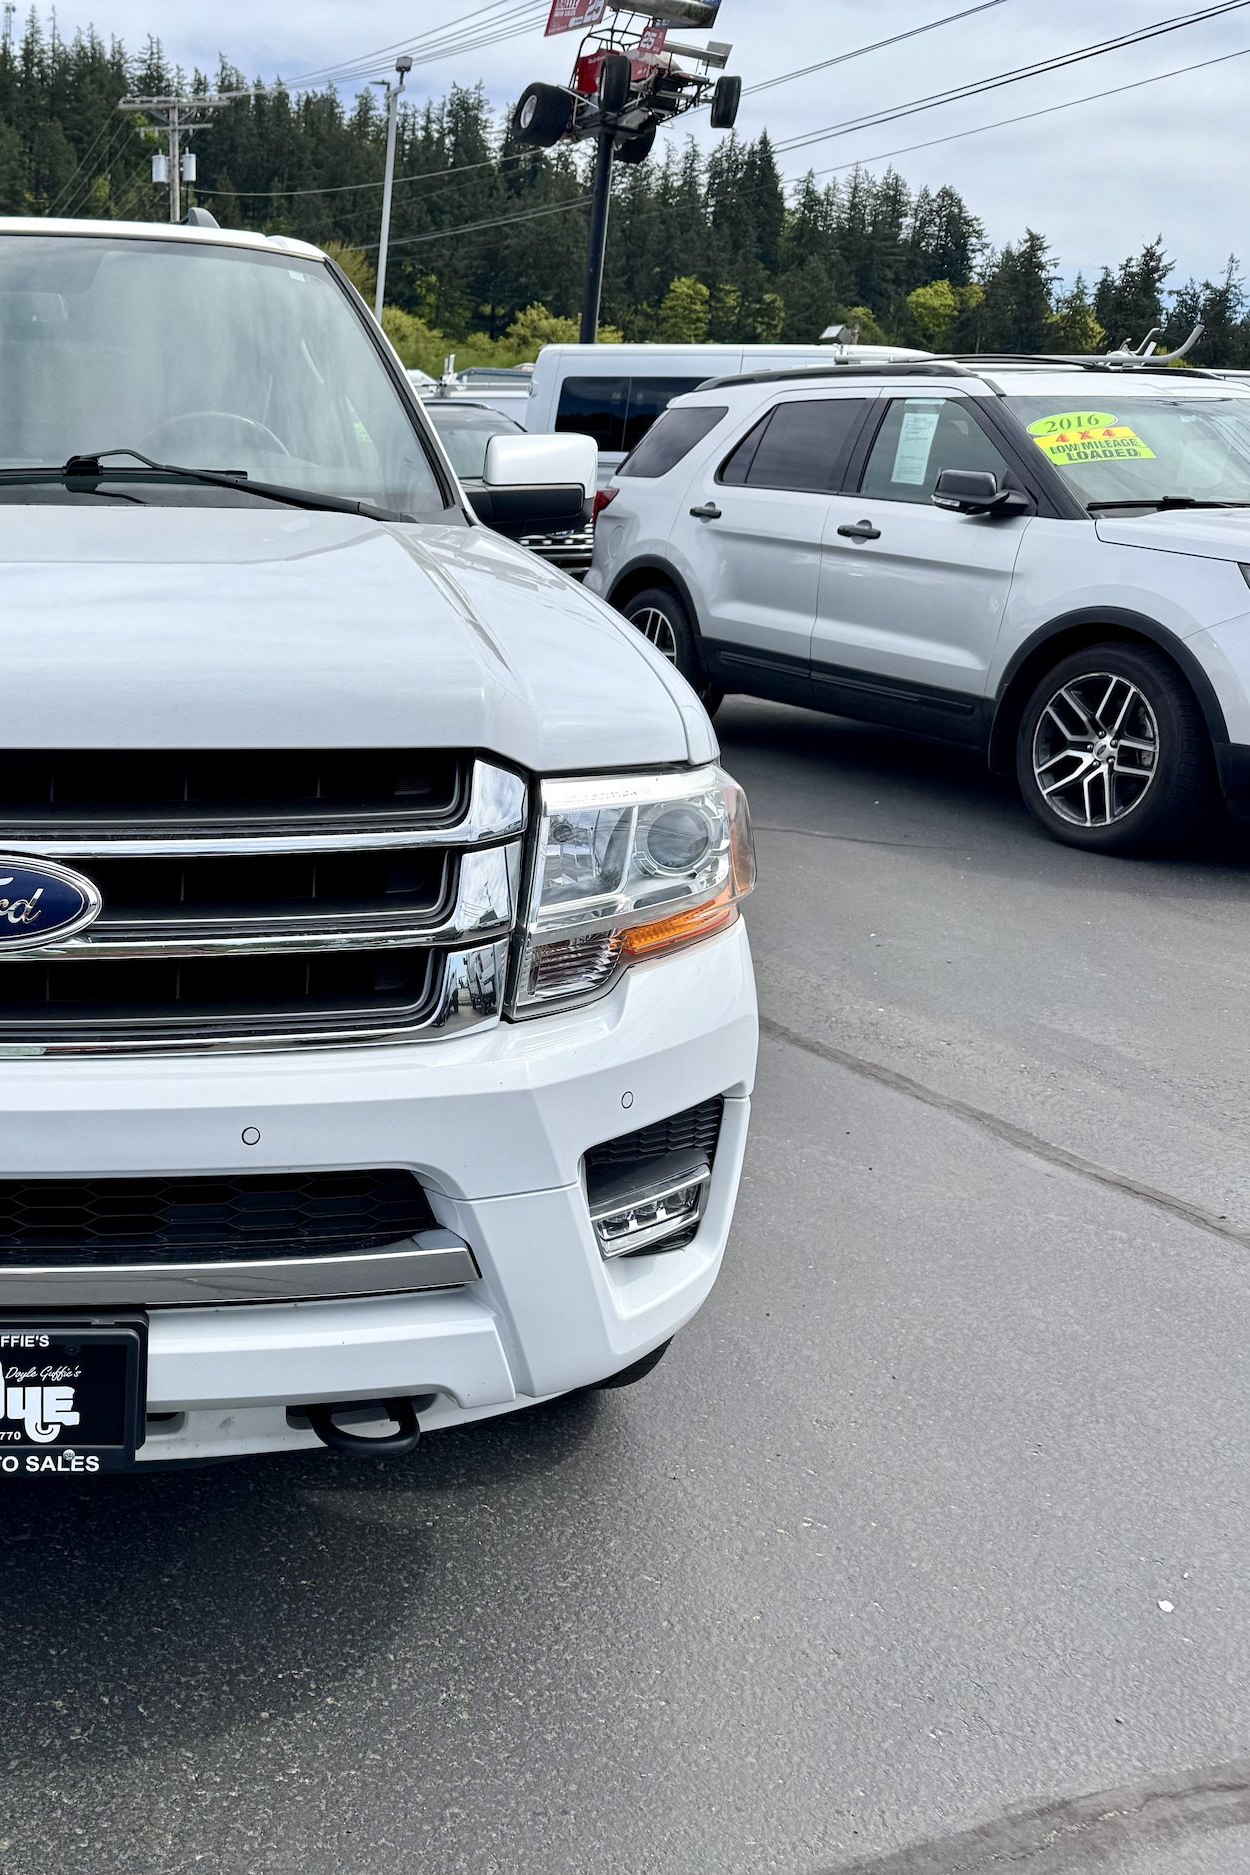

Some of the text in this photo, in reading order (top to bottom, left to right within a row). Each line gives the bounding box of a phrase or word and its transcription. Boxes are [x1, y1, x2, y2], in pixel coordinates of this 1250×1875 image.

[640, 31, 658, 49] 25
[1045, 414, 1099, 433] 2016
[1055, 428, 1116, 443] 4 X 4
[1049, 438, 1140, 455] LOW MILEAGE
[1066, 448, 1140, 462] LOADED
[5, 1365, 82, 1382] Doyle Guffie's
[25, 1455, 100, 1473] SALES
